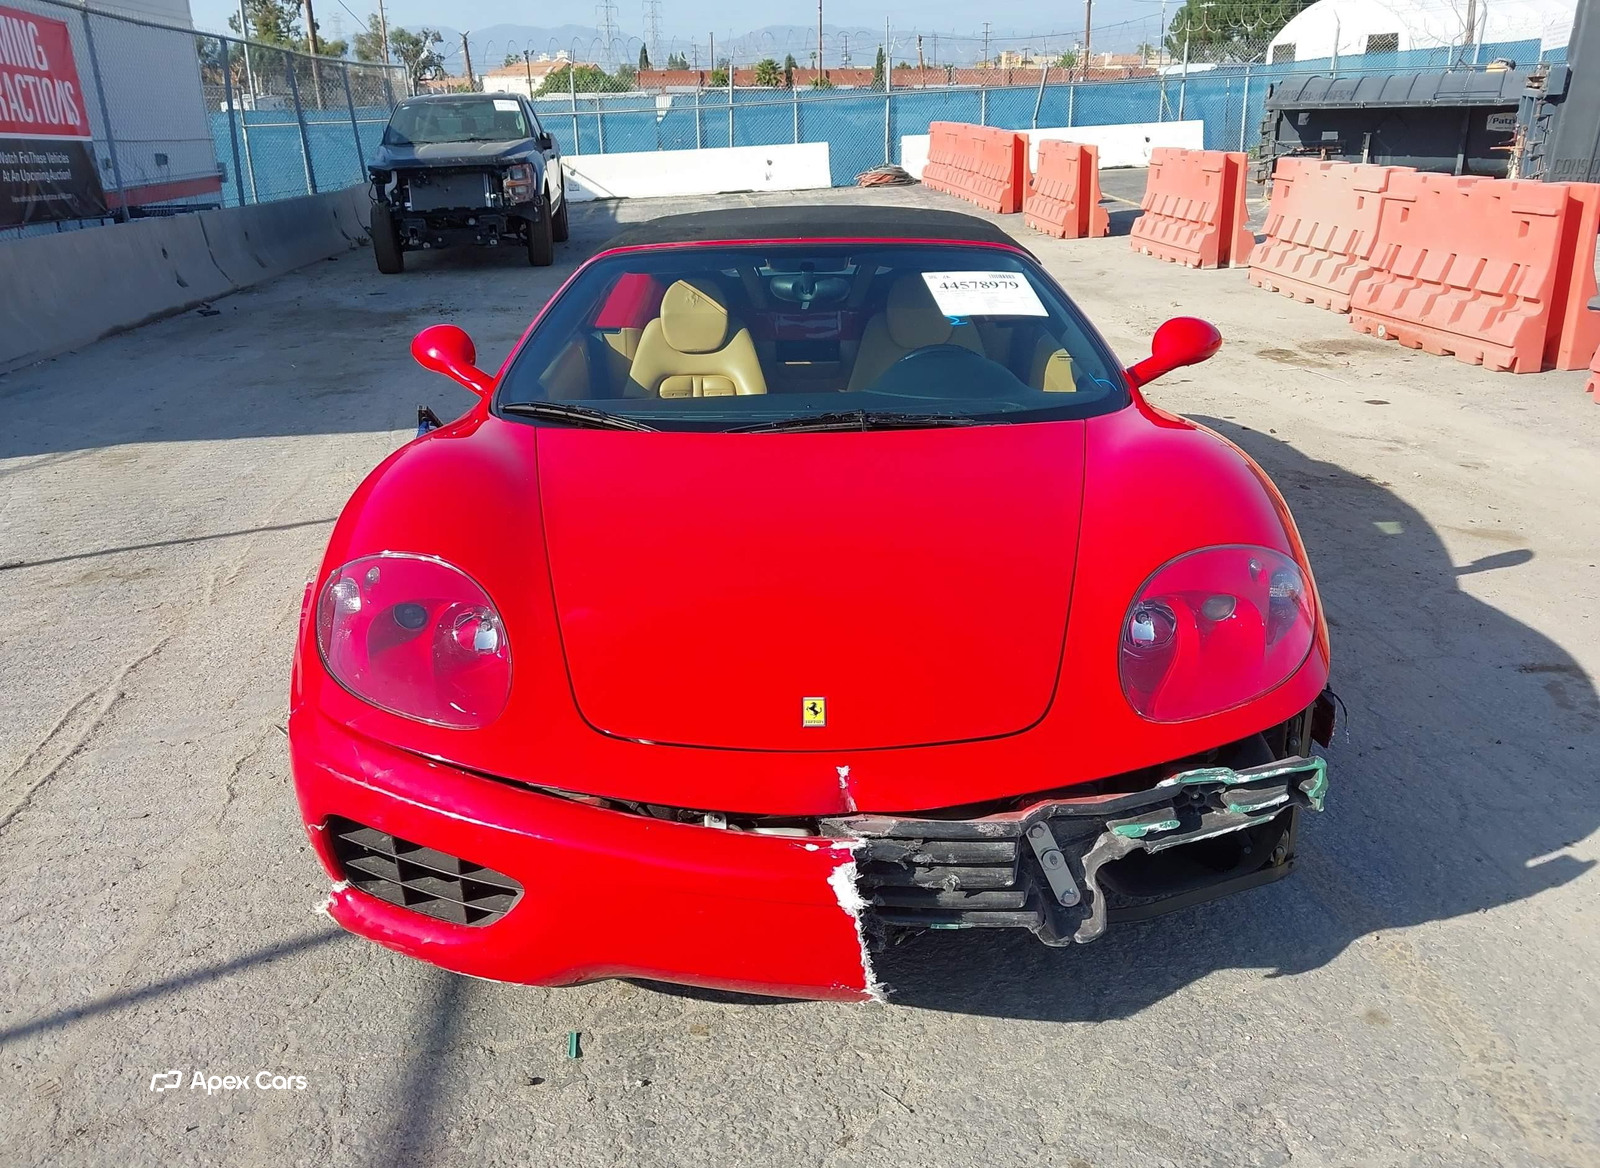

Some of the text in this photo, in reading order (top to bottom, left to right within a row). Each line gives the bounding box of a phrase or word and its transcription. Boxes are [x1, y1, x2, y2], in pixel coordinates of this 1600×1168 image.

[45, 151, 70, 164] Vehicles
[11, 169, 20, 182] An
[19, 168, 51, 184] Upcoming
[939, 281, 1019, 290] 44578979
